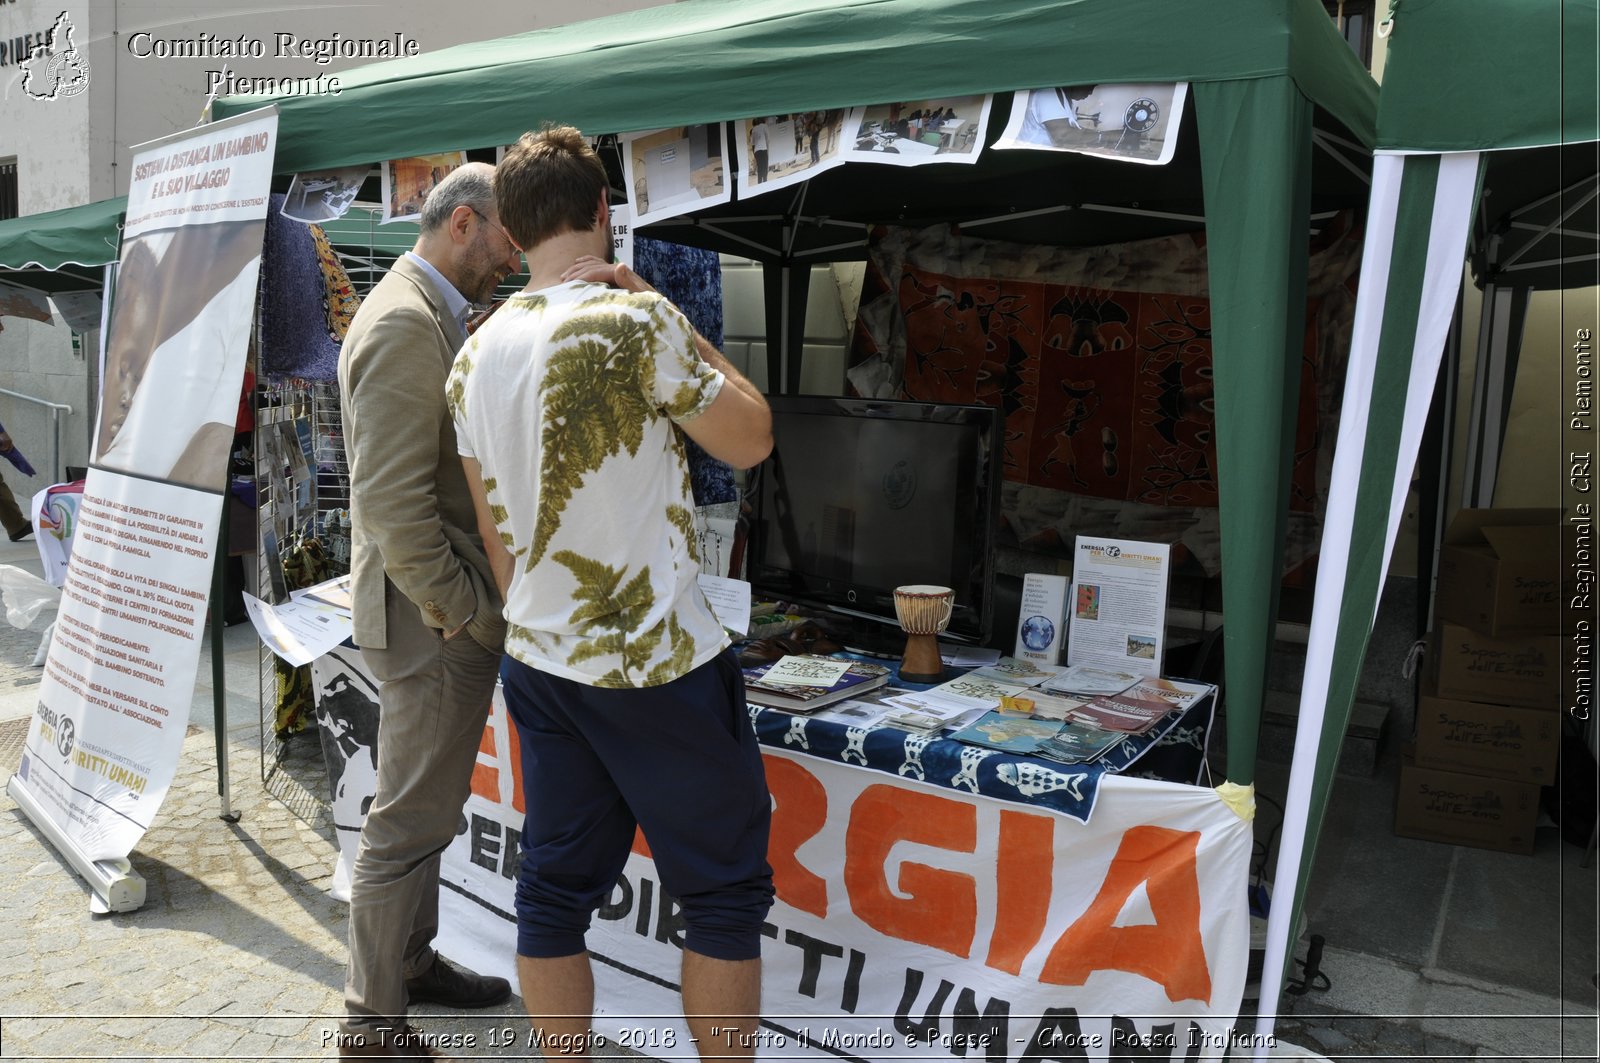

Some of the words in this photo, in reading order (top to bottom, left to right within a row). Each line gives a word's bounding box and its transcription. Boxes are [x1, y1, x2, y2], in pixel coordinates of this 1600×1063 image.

[163, 156, 170, 173] A
[170, 145, 211, 171] DISTANZA
[212, 142, 226, 161] UN
[226, 132, 269, 159] BAMBINO
[152, 183, 159, 199] E
[166, 177, 183, 195] SUO
[185, 168, 231, 193] VILLAGGIO
[619, 225, 628, 234] DE
[129, 506, 158, 519] PERMETTE
[166, 515, 197, 529] GARANTIRE
[128, 519, 136, 528] LA
[137, 521, 170, 536] POSSIBILITÀ
[171, 530, 178, 538] DI
[178, 532, 199, 544] ANDARE
[138, 535, 174, 550] RIMANENDO
[174, 544, 184, 553] NEL
[184, 546, 209, 560] PROPRIO
[1080, 543, 1105, 551] ENERGIA
[110, 569, 124, 579] SOLO
[125, 573, 133, 581] LA
[134, 574, 147, 584] VITA
[148, 579, 158, 588] DEI
[159, 582, 181, 594] SINGOLI
[123, 586, 135, 595] CON
[143, 590, 156, 601] 30%
[157, 595, 174, 606] DELLA
[174, 601, 194, 612] QUOTA
[119, 611, 147, 625] UMANISTI
[129, 600, 151, 612] CENTRI
[151, 607, 158, 615] DI
[158, 609, 195, 626] FORMAZIONE
[1460, 644, 1510, 658] Sapori
[94, 657, 104, 666] DEL
[105, 661, 132, 676] BAMBINO
[128, 655, 158, 671] SANITARIA
[159, 665, 164, 673] E
[1467, 661, 1545, 677] dell'Eremo
[103, 686, 112, 696] DA
[112, 690, 138, 706] VERSARE
[138, 699, 150, 709] SUL
[150, 704, 169, 717] CONTO
[37, 701, 58, 730] ENERGIA
[1438, 714, 1488, 730] Sapori
[1445, 733, 1522, 750] dell'Eremo
[109, 764, 148, 794] UMANI
[1418, 784, 1469, 800] Sapori
[1425, 800, 1500, 820] dell'Eremo
